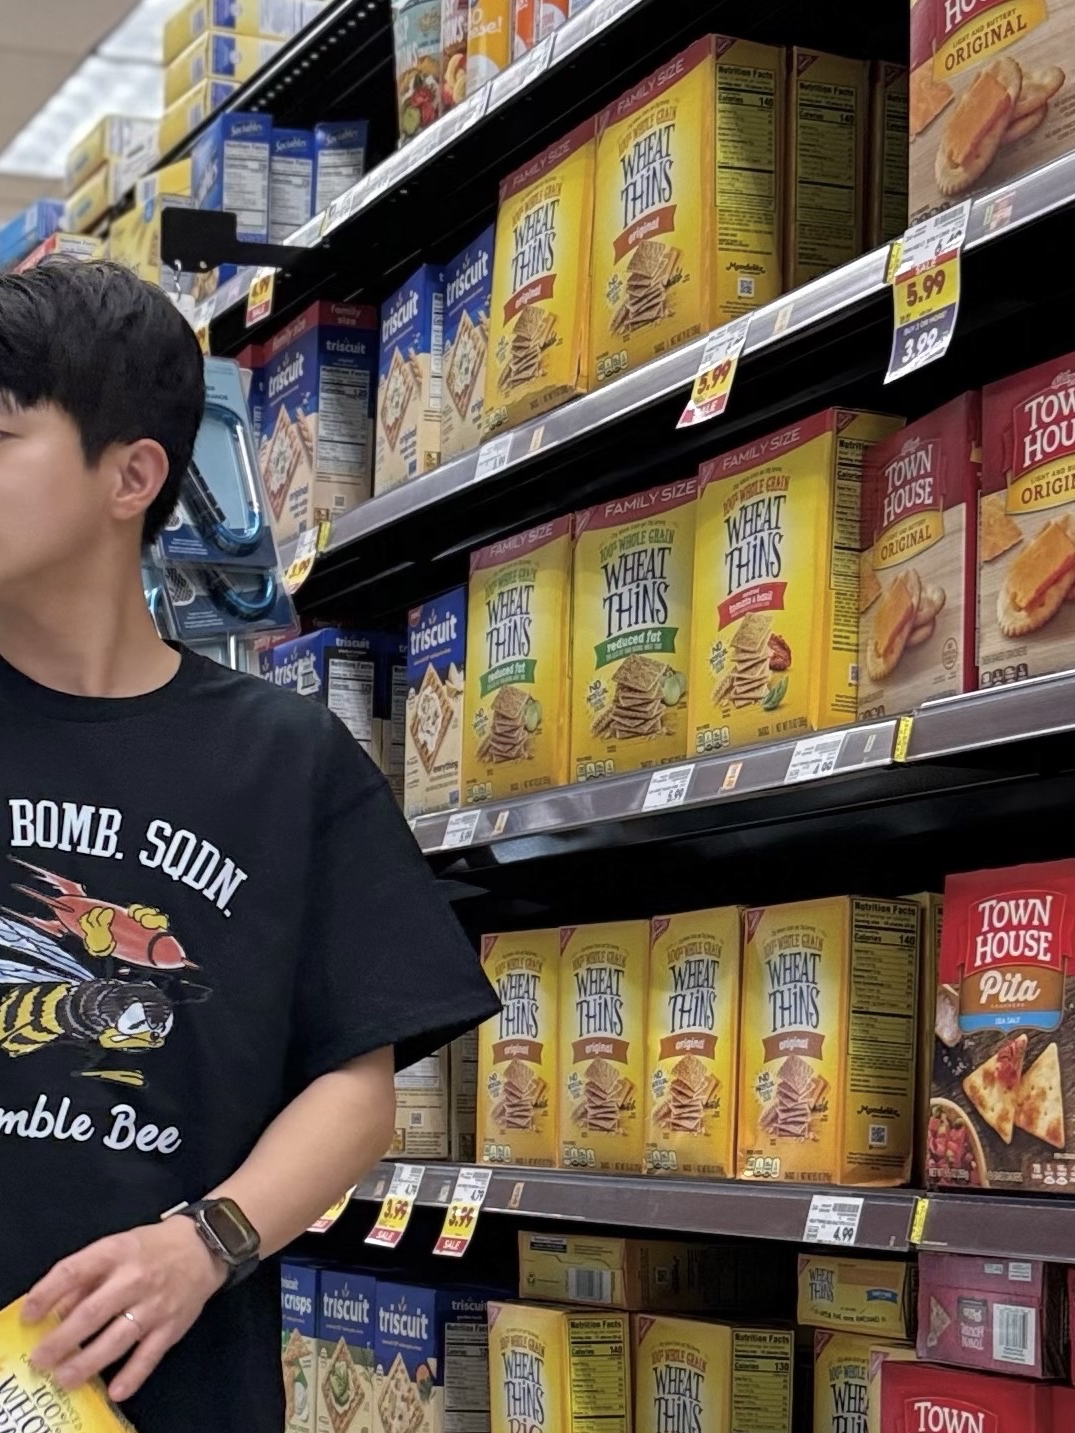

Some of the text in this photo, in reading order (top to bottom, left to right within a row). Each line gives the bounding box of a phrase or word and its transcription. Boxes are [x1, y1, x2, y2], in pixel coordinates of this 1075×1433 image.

[944, 13, 1027, 72] ORIGINAL
[656, 57, 684, 87] SIZE
[619, 123, 676, 186] WHEAT
[512, 199, 560, 253] WHEAT
[445, 250, 490, 306] triscuit
[906, 269, 946, 308] 5.99
[381, 289, 419, 344] triscuit
[326, 340, 366, 355] triscuit
[901, 327, 938, 364] 3.99
[268, 351, 305, 398] triscuit
[697, 358, 732, 396] 5.99
[722, 427, 802, 471] FAMILY SIZE
[885, 443, 933, 495] TOWN
[604, 480, 697, 519] FAMILY SIZE
[882, 477, 934, 528] HOUSE
[724, 494, 787, 548] WHEAT
[489, 523, 554, 558] FAMILY SIZE
[881, 525, 931, 561] ORIGINAL
[600, 547, 672, 595] WHEAT
[486, 584, 535, 629] WHEAT
[335, 636, 371, 650] triscuit
[410, 612, 458, 656] triscuit
[606, 630, 663, 653] reduced fat
[8, 798, 125, 860] BOMB.
[137, 819, 249, 918] SQDN.
[854, 901, 916, 917] Nutrition Facts
[978, 895, 1053, 933] TOWN
[973, 929, 1052, 967] HOUSE
[495, 973, 541, 1001] WHEAT
[574, 967, 624, 999] WHEAT
[668, 959, 720, 993] WHEAT
[765, 952, 821, 989] WHEAT
[979, 970, 1042, 1005] Pita
[585, 1043, 613, 1056] original
[675, 1037, 705, 1051] original
[779, 1037, 808, 1051] original
[102, 1103, 182, 1155] Bee
[383, 1198, 410, 1221] 3.99
[376, 1230, 394, 1241] SALE
[443, 1239, 462, 1251] SALE
[832, 1225, 856, 1245] 4.99
[284, 1292, 313, 1317] crisps
[323, 1293, 371, 1325] triscuit
[379, 1305, 430, 1341] triscuit
[734, 1333, 790, 1344] Nutrition Facts
[501, 1349, 544, 1387] WHEAT
[652, 1363, 705, 1404] WHEAT
[774, 1361, 790, 1372] 130
